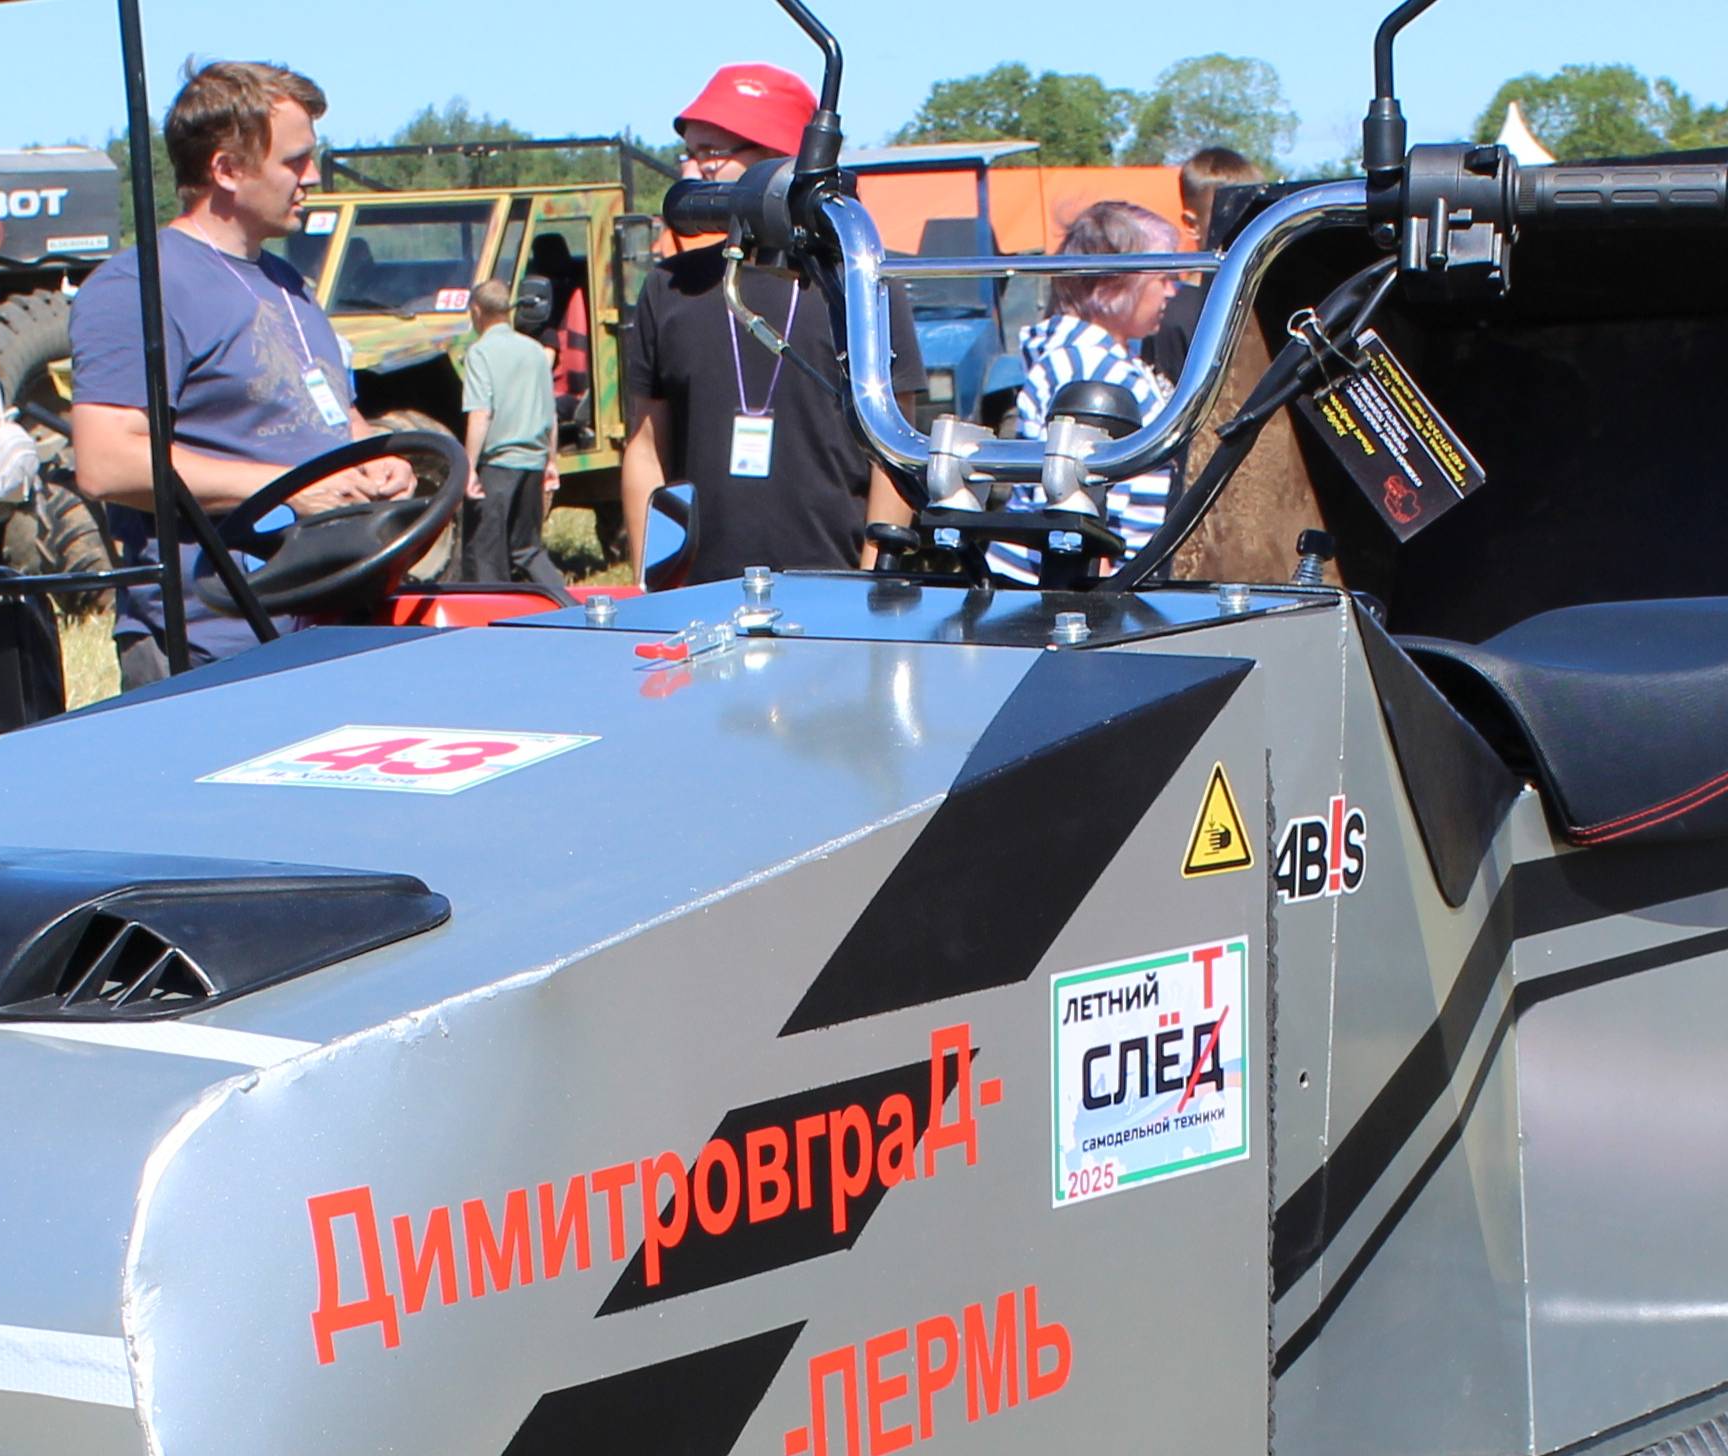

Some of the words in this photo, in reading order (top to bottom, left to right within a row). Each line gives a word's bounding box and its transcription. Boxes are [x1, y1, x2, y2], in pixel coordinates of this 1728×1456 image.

[295, 738, 519, 775] 43
[1063, 971, 1159, 1026] ЛЕТНИЙ
[1192, 945, 1224, 1010] Т
[1081, 1010, 1226, 1112] СЛЁД
[1082, 1117, 1171, 1152] самодельной
[1173, 1107, 1226, 1130] техники
[306, 1022, 1004, 1365] ДимитровграД-
[1068, 1162, 1114, 1200] 2025
